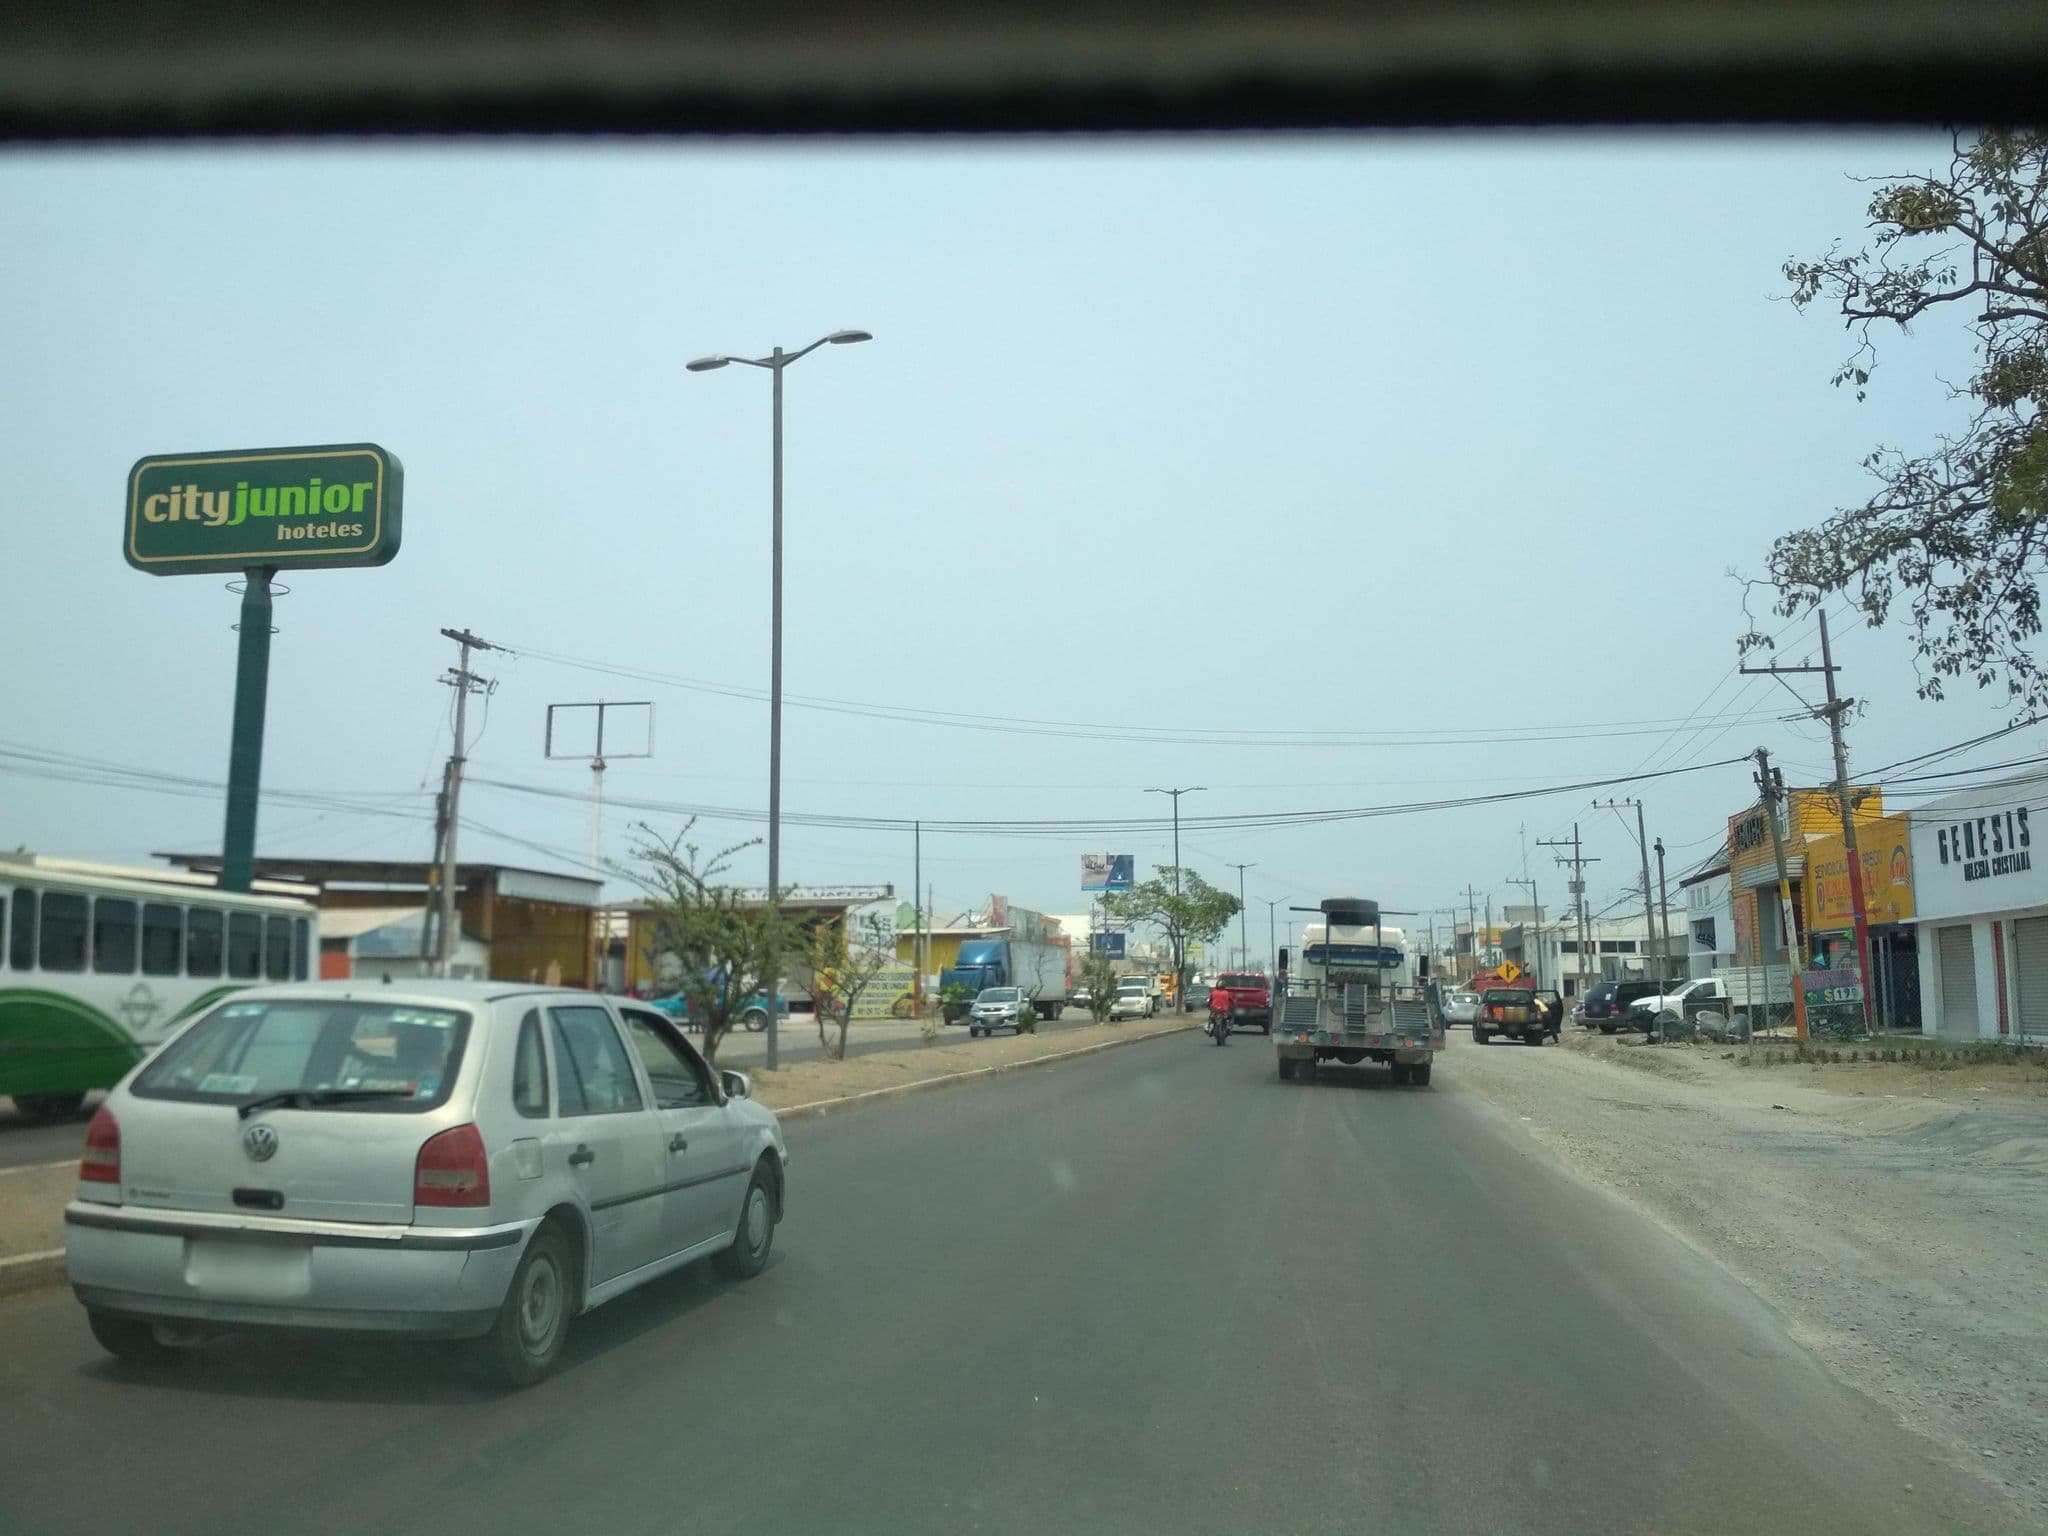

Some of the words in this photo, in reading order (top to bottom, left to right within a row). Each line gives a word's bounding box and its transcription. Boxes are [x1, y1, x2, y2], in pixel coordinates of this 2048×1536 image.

[276, 522, 364, 541] hoteles
[1937, 806, 2031, 865] GENESIS
[1963, 859, 1990, 881] IGLESIA
[1991, 850, 2031, 876] CRISTIANA
